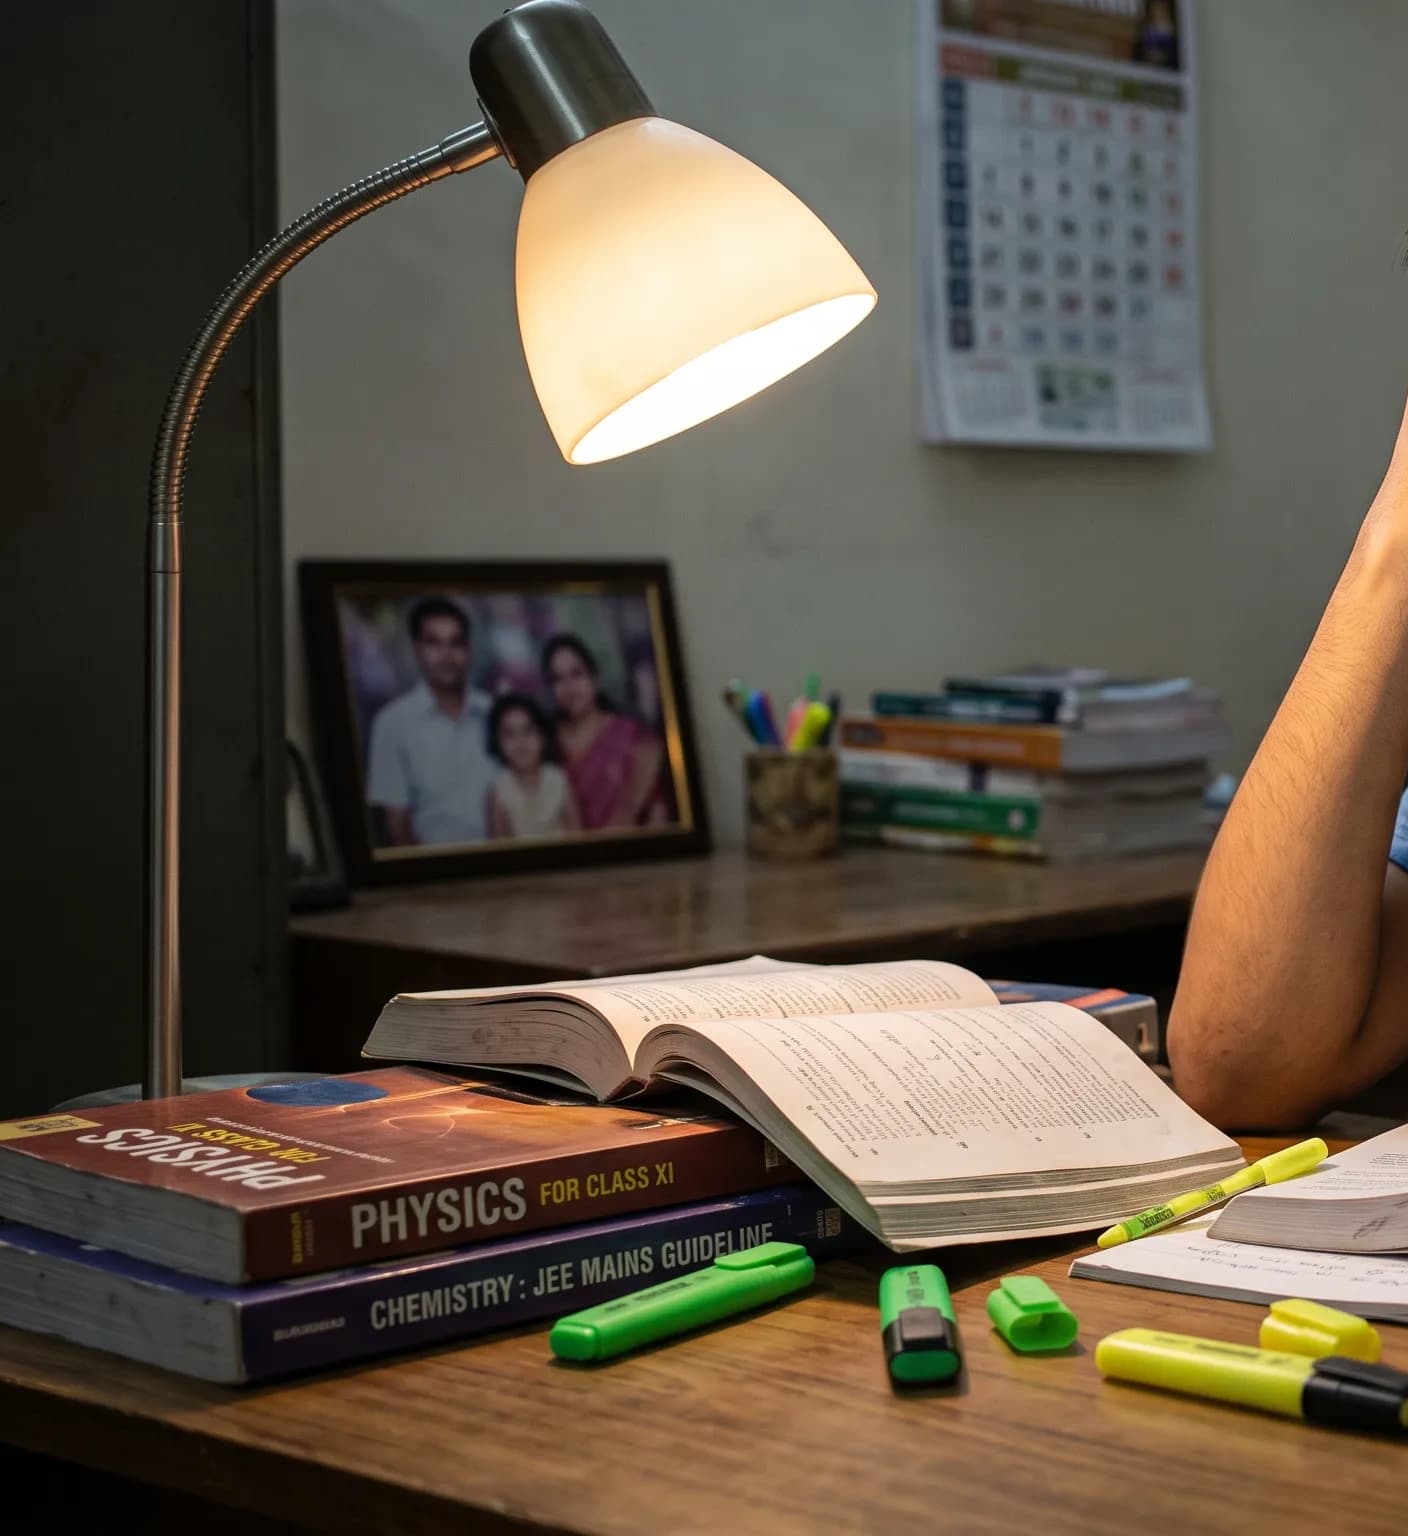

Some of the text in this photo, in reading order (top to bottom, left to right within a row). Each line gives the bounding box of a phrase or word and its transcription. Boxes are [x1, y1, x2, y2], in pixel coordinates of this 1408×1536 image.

[76, 1128, 326, 1190] PHYSICS
[351, 1177, 527, 1249] PHYSICS
[540, 1178, 580, 1206] FOR
[586, 1169, 649, 1198] CLASS
[655, 1161, 675, 1186] XI
[371, 1273, 514, 1330] CHEMISTRY
[533, 1261, 574, 1297] JEE
[581, 1250, 655, 1287] MAINS
[661, 1222, 774, 1270] GUIDELINE
